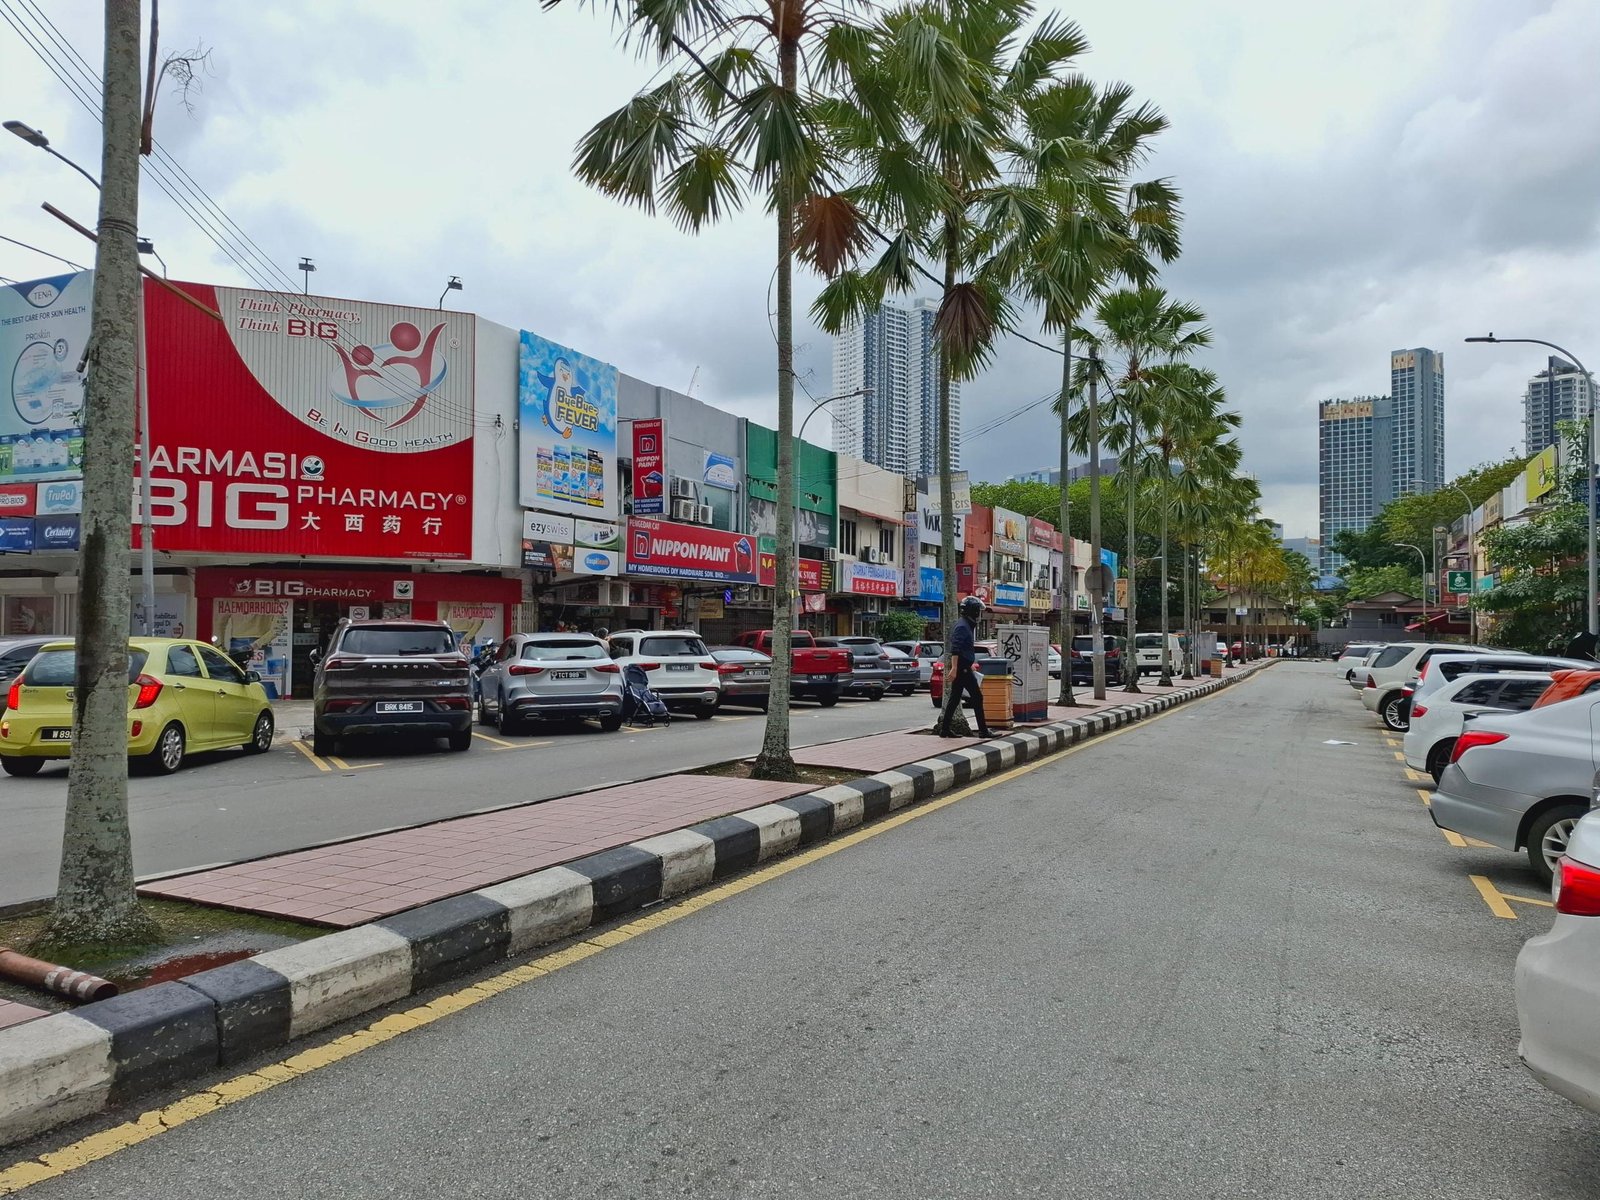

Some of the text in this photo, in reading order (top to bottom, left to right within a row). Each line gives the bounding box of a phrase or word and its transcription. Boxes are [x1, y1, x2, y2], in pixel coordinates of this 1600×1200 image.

[33, 290, 53, 300] TENA
[12, 316, 24, 324] BEST
[25, 313, 38, 322] CARE
[40, 311, 50, 319] FOR
[51, 309, 64, 318] SKIN
[64, 306, 86, 316] HEALTH
[239, 298, 361, 323] Think Pharmacy,
[239, 317, 338, 340] Think BIG
[556, 405, 598, 431] FEVER
[404, 432, 453, 447] HEALTH
[636, 455, 660, 463] NIPPON
[131, 476, 289, 530] BIG
[530, 522, 569, 536] ezyswiss
[629, 519, 660, 530] PENGEDAR CAT
[45, 526, 76, 539] Certainty
[651, 538, 731, 563] NIPPON PAINT
[628, 563, 638, 571] MY
[637, 564, 671, 575] HOMEWORKS
[670, 567, 679, 575] DIY
[679, 567, 704, 578] HARDWARE
[255, 580, 373, 598] BIG PHARMACY
[384, 703, 397, 711] BRK
[52, 730, 59, 739] W
